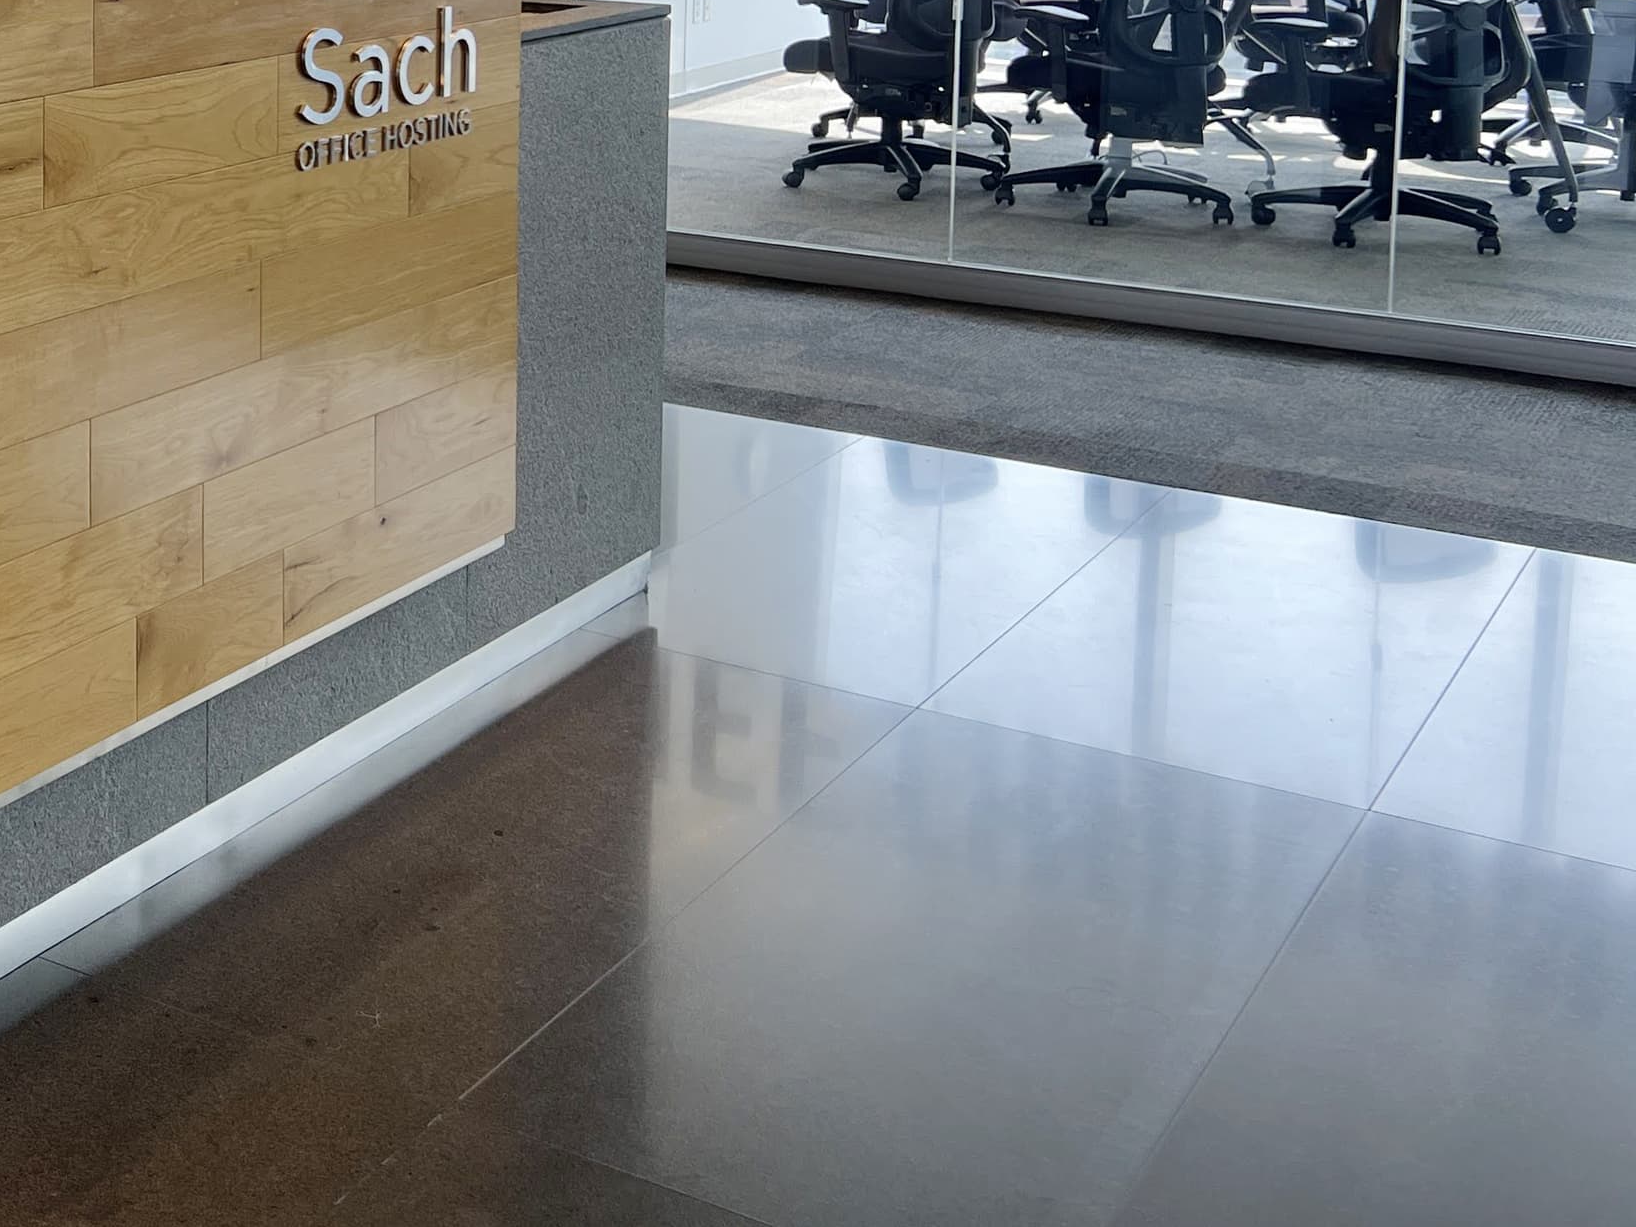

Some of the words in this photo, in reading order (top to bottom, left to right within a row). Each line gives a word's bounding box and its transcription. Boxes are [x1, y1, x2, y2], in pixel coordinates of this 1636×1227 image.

[298, 6, 476, 125] Sach
[296, 127, 378, 172] OFFICE
[381, 109, 472, 151] HOSTING
